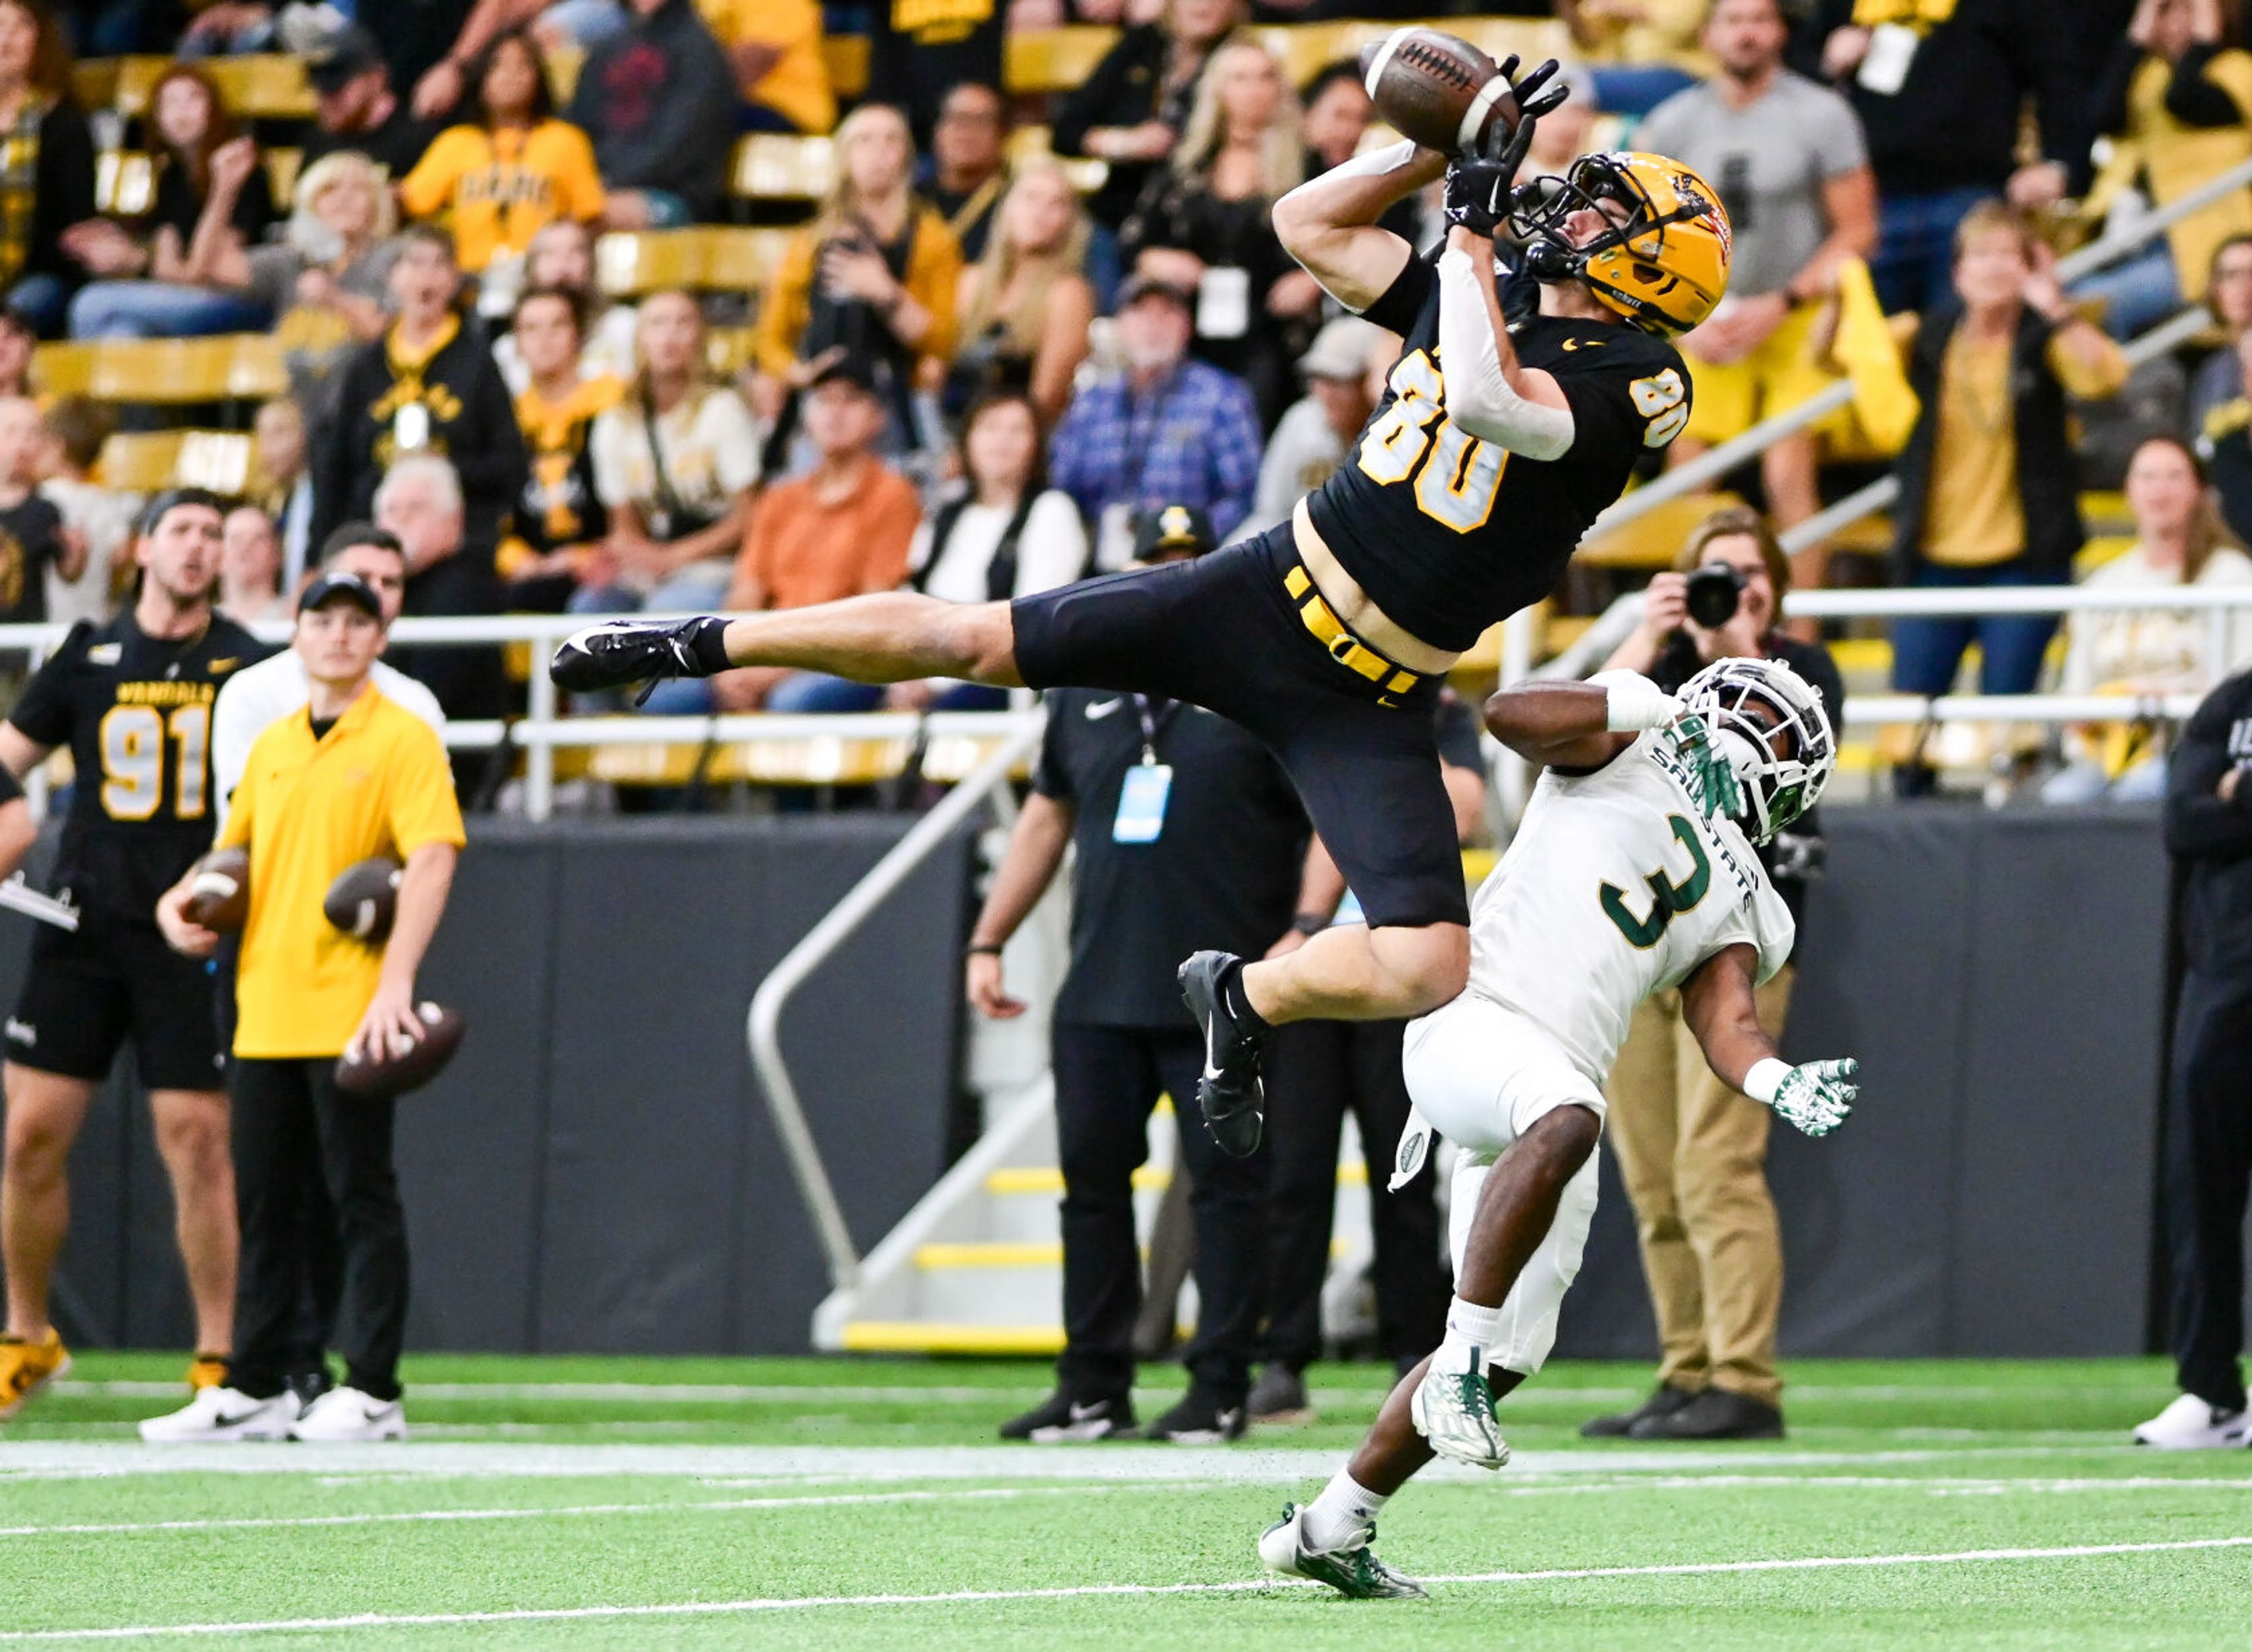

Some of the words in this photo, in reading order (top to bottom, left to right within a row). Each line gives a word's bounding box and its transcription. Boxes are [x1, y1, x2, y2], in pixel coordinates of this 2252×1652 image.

[1357, 348, 1510, 534] 80
[1629, 367, 1688, 449] 80
[99, 703, 211, 820] 91
[1597, 812, 1711, 950] 3
[1700, 815, 1753, 914] STATE
